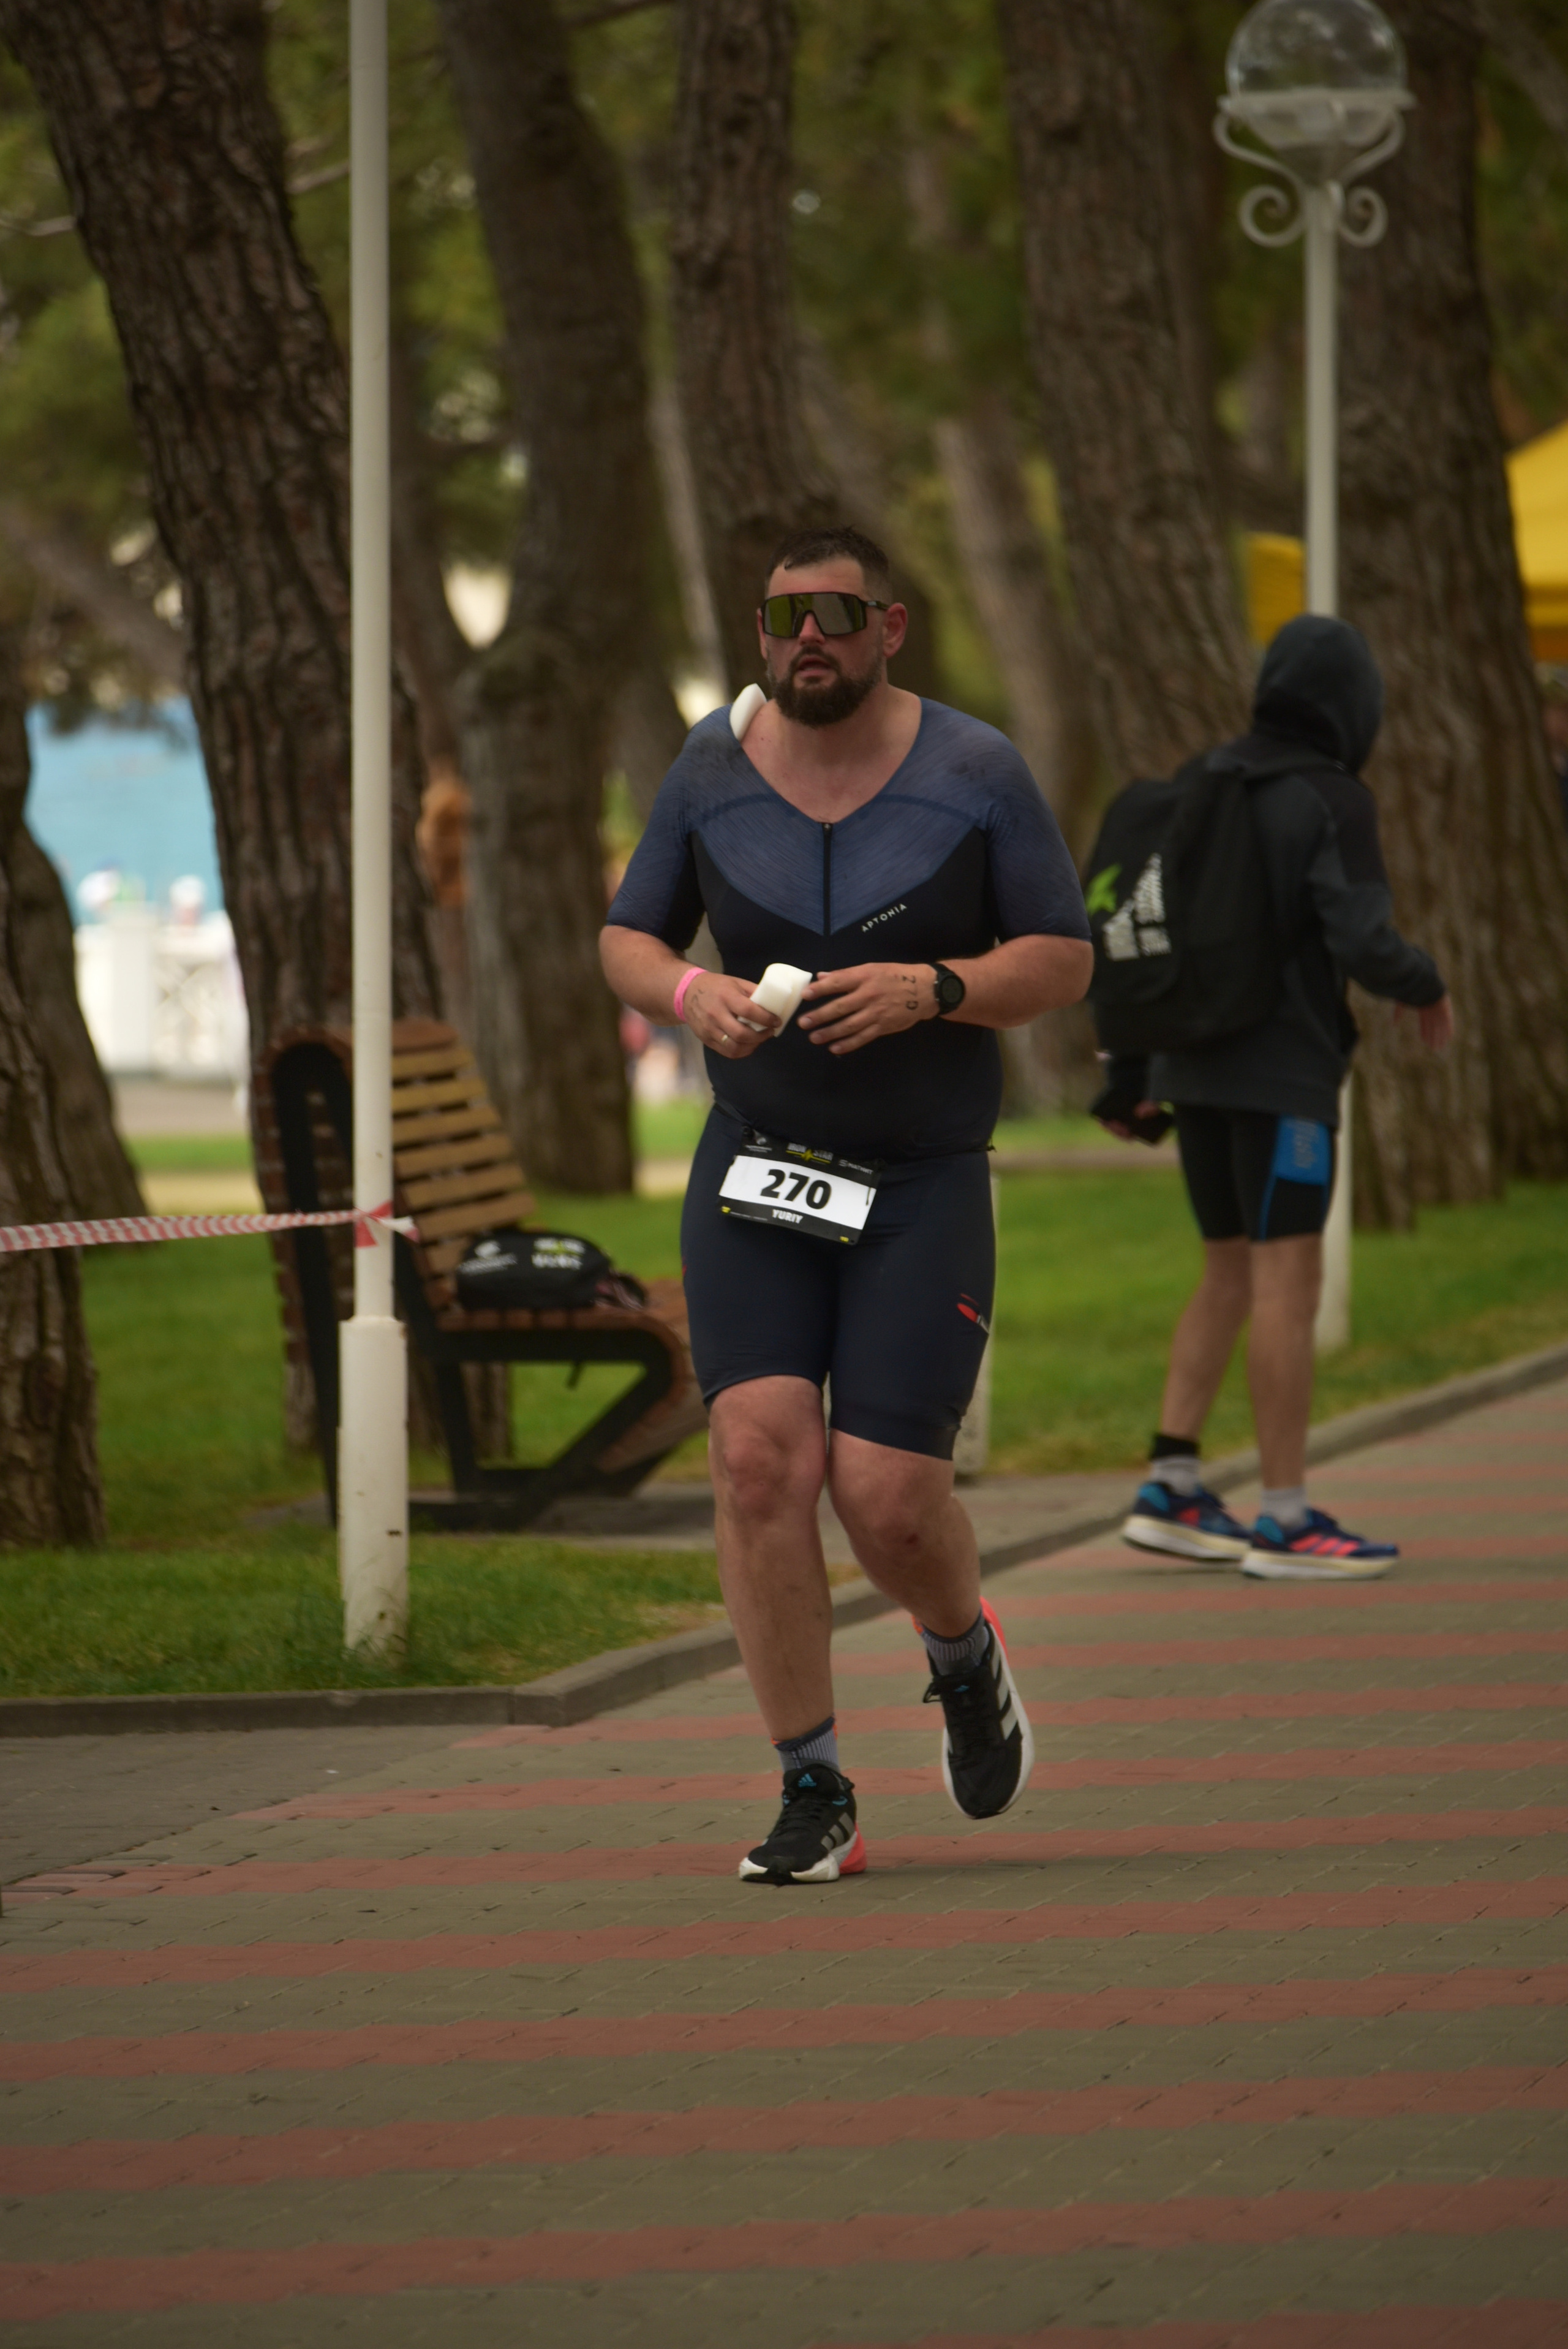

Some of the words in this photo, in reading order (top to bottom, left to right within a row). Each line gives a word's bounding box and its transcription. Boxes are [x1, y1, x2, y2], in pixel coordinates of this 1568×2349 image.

[861, 903, 907, 932] APTONIA
[760, 1169, 832, 1210] 270
[772, 1209, 804, 1224] YURIY
